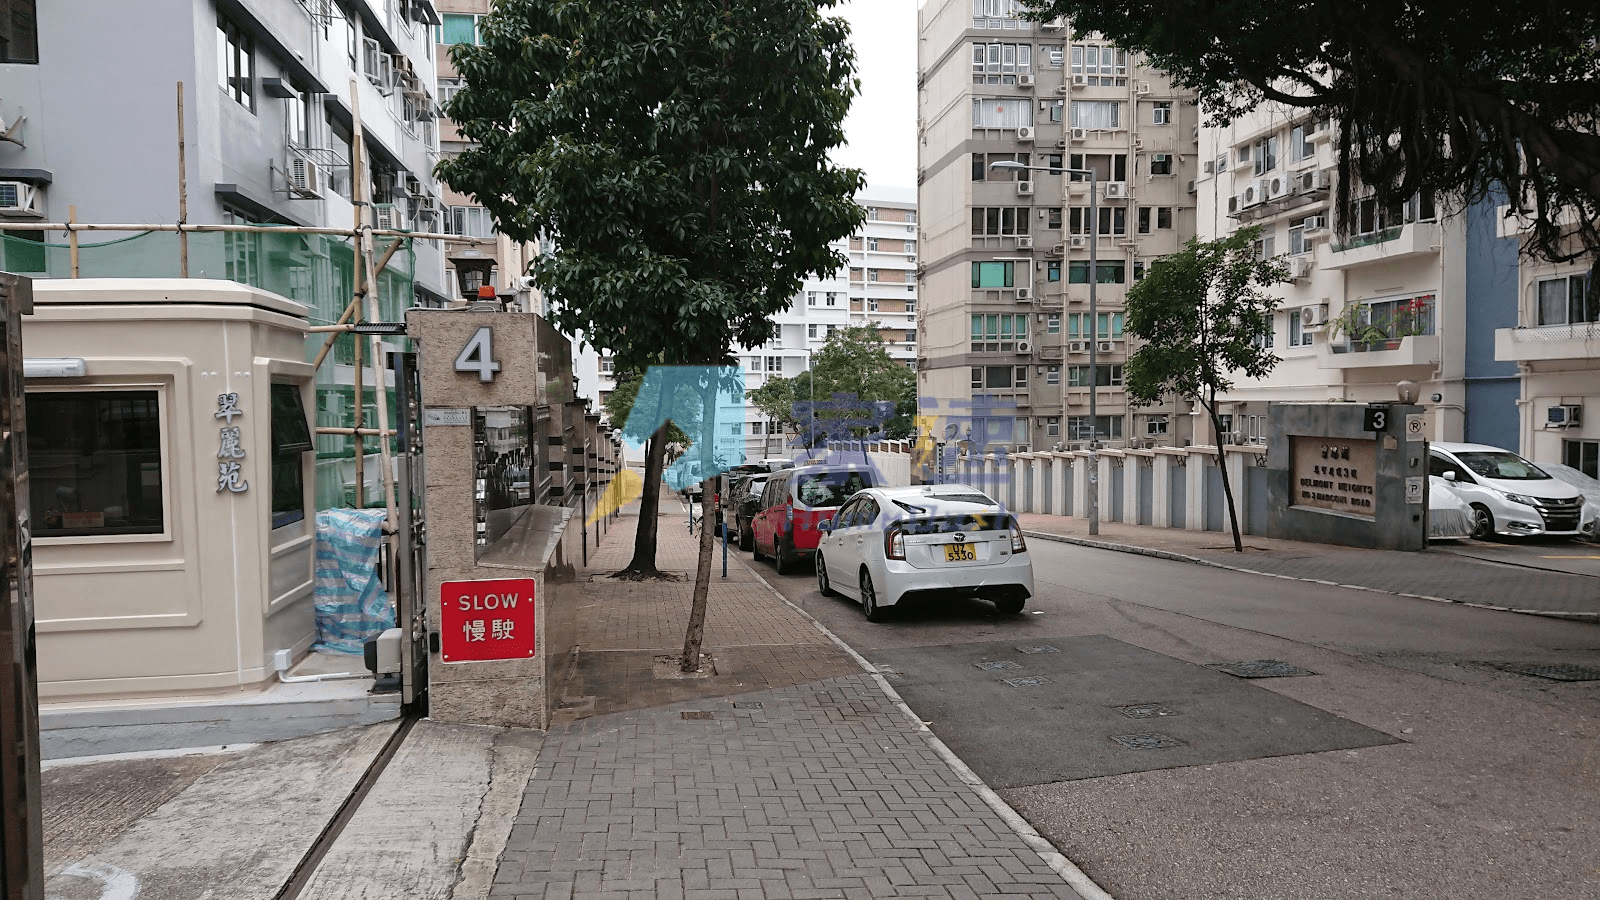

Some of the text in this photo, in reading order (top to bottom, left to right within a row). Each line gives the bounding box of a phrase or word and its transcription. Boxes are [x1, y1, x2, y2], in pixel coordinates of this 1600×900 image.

[453, 325, 502, 383] 4
[1372, 411, 1385, 429] 3
[214, 392, 249, 493] 翠麗苑
[1300, 478, 1373, 495] BELMONT HEIGHTS
[1350, 497, 1371, 508] ROAD
[948, 552, 974, 562] 5330
[952, 544, 967, 554] UZ
[458, 592, 519, 611] SLOW
[462, 618, 515, 643] 慢駛
